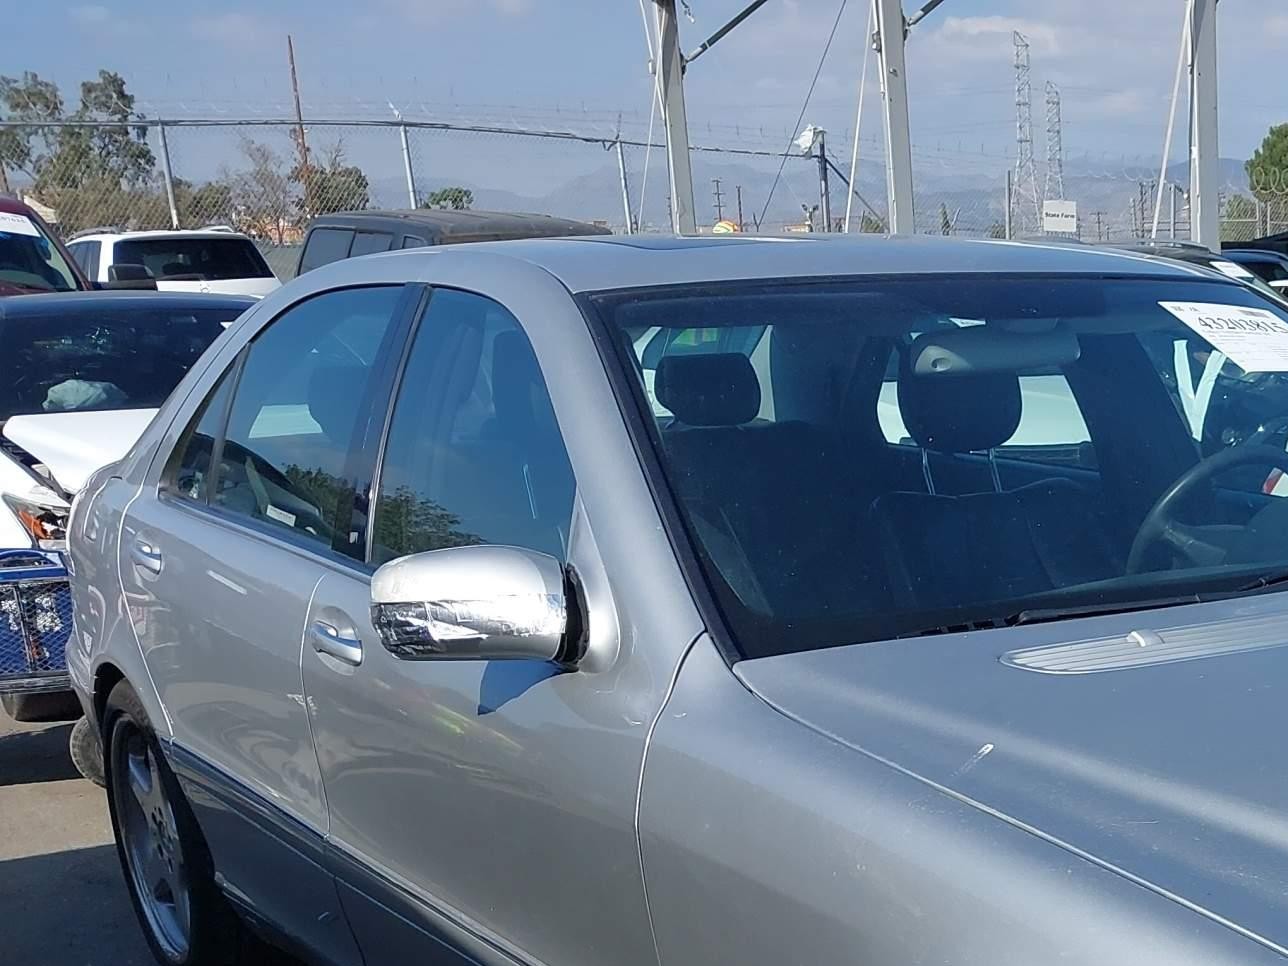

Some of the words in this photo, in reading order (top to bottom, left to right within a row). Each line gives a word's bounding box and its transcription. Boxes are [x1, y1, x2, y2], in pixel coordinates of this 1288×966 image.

[1044, 211, 1060, 219] State
[1061, 211, 1076, 219] Farm
[1198, 316, 1288, 334] 43203815
